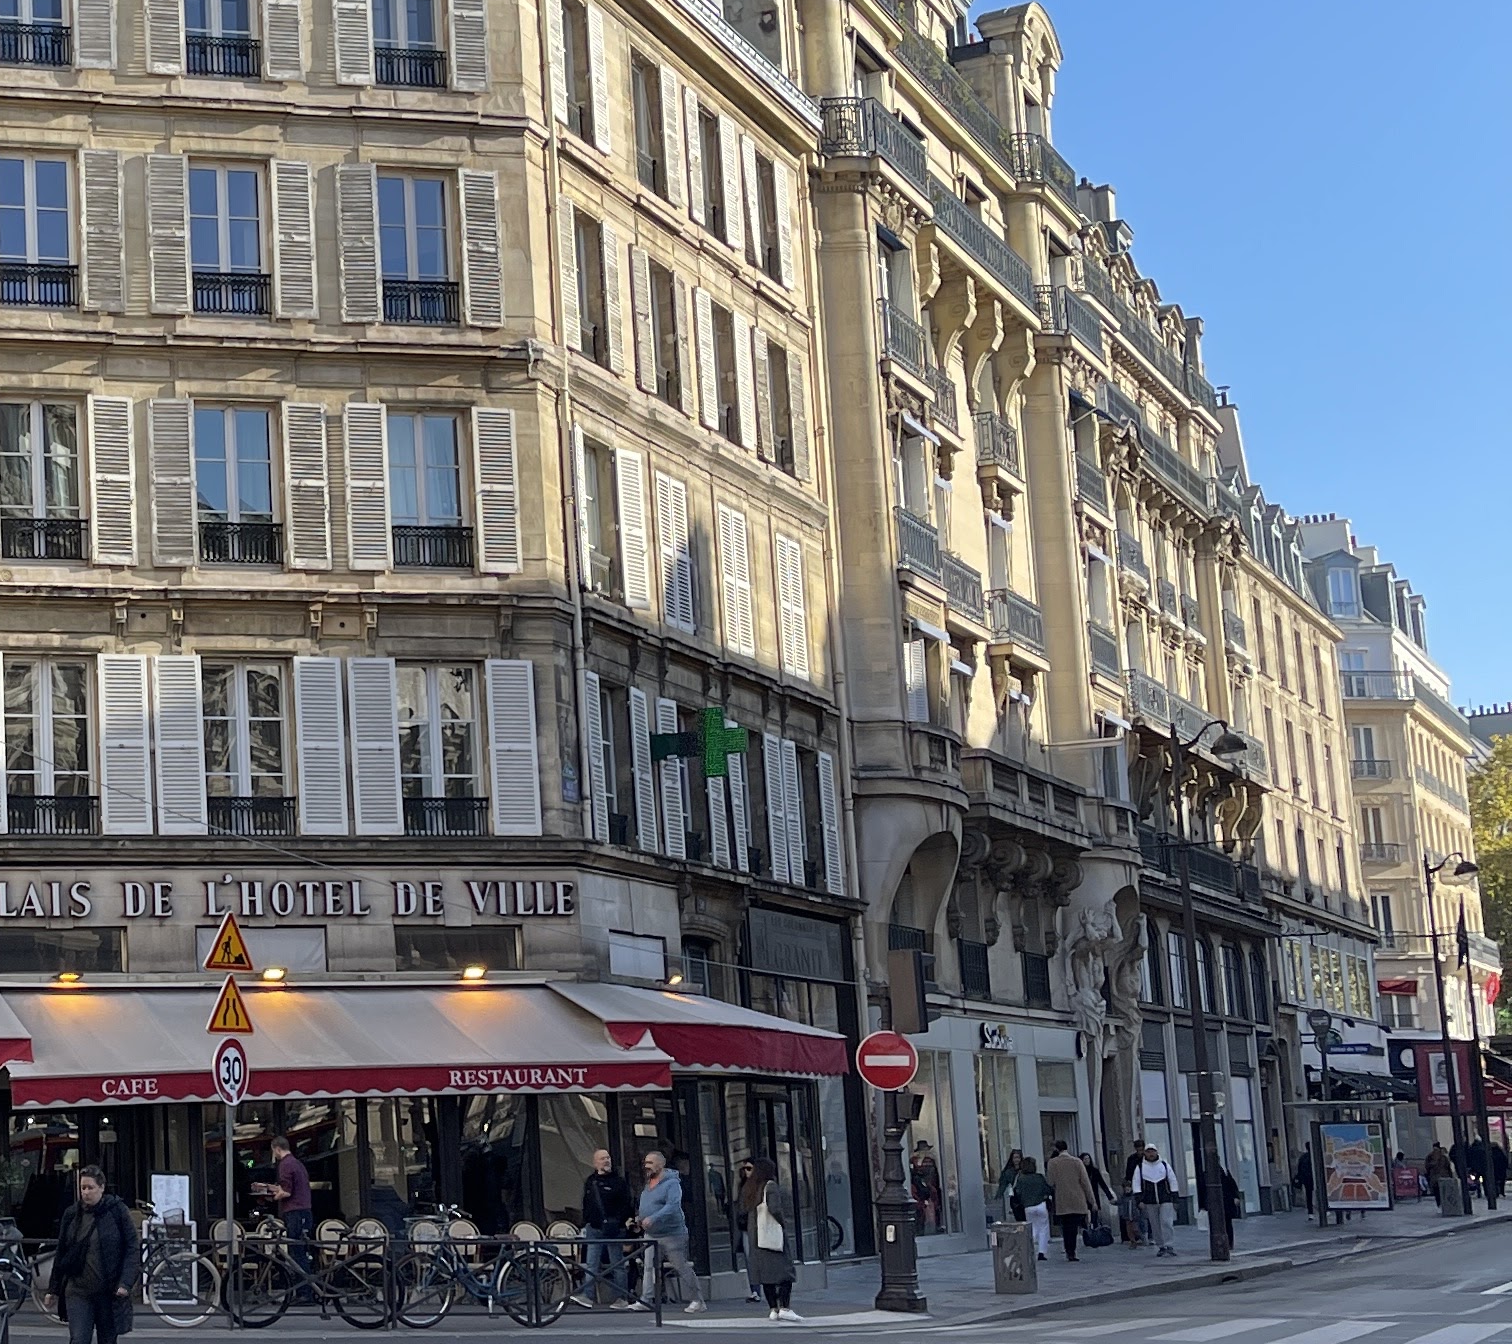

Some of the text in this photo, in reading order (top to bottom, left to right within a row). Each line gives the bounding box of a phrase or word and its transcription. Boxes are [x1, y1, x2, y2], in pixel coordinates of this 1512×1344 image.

[123, 881, 174, 918] DE
[203, 872, 373, 917] L'HOTEL
[392, 880, 445, 917] DE
[468, 880, 576, 917] VILLE
[222, 1055, 242, 1085] 30
[448, 1067, 588, 1087] RESTAURANT
[101, 1077, 159, 1096] CAFE
